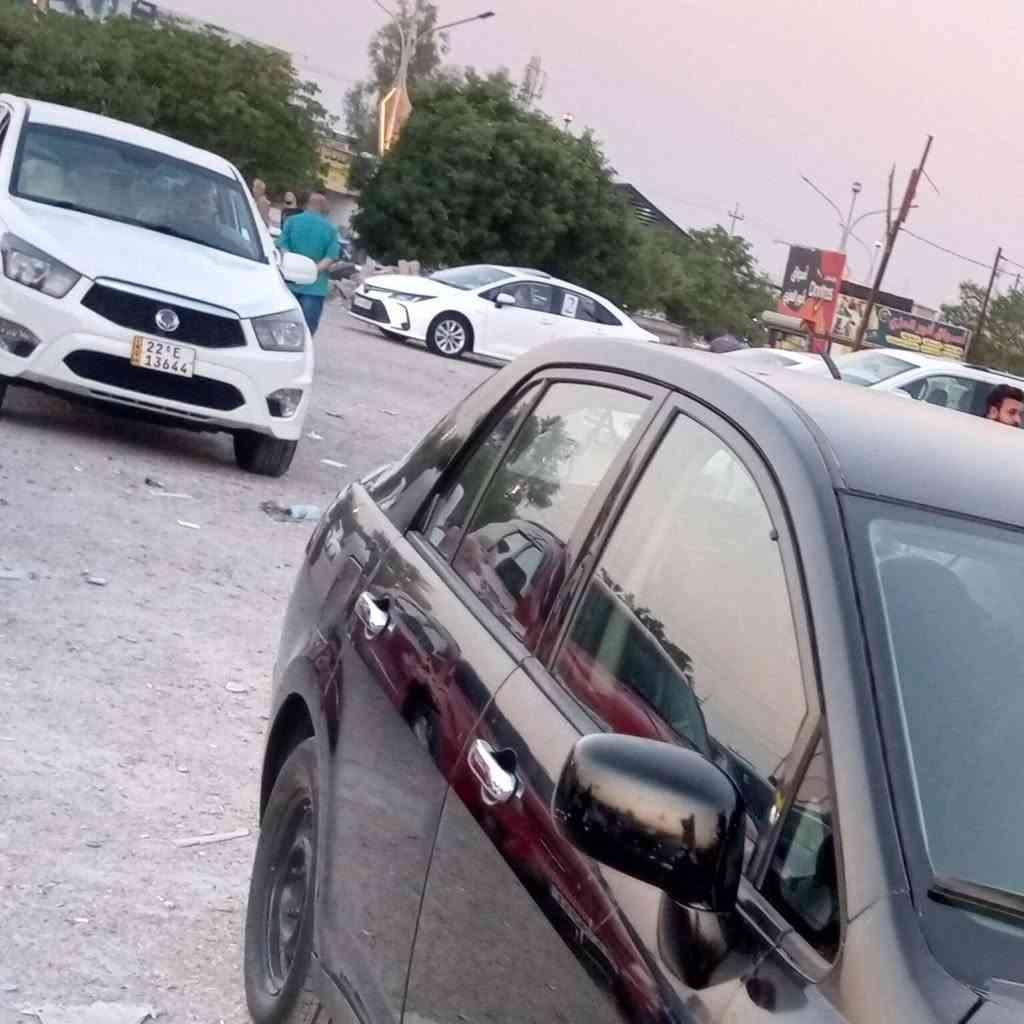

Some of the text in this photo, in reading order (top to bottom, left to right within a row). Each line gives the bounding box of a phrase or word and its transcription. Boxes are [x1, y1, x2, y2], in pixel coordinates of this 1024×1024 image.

[147, 341, 163, 354] 22
[173, 347, 180, 359] E
[144, 355, 187, 373] 13644
